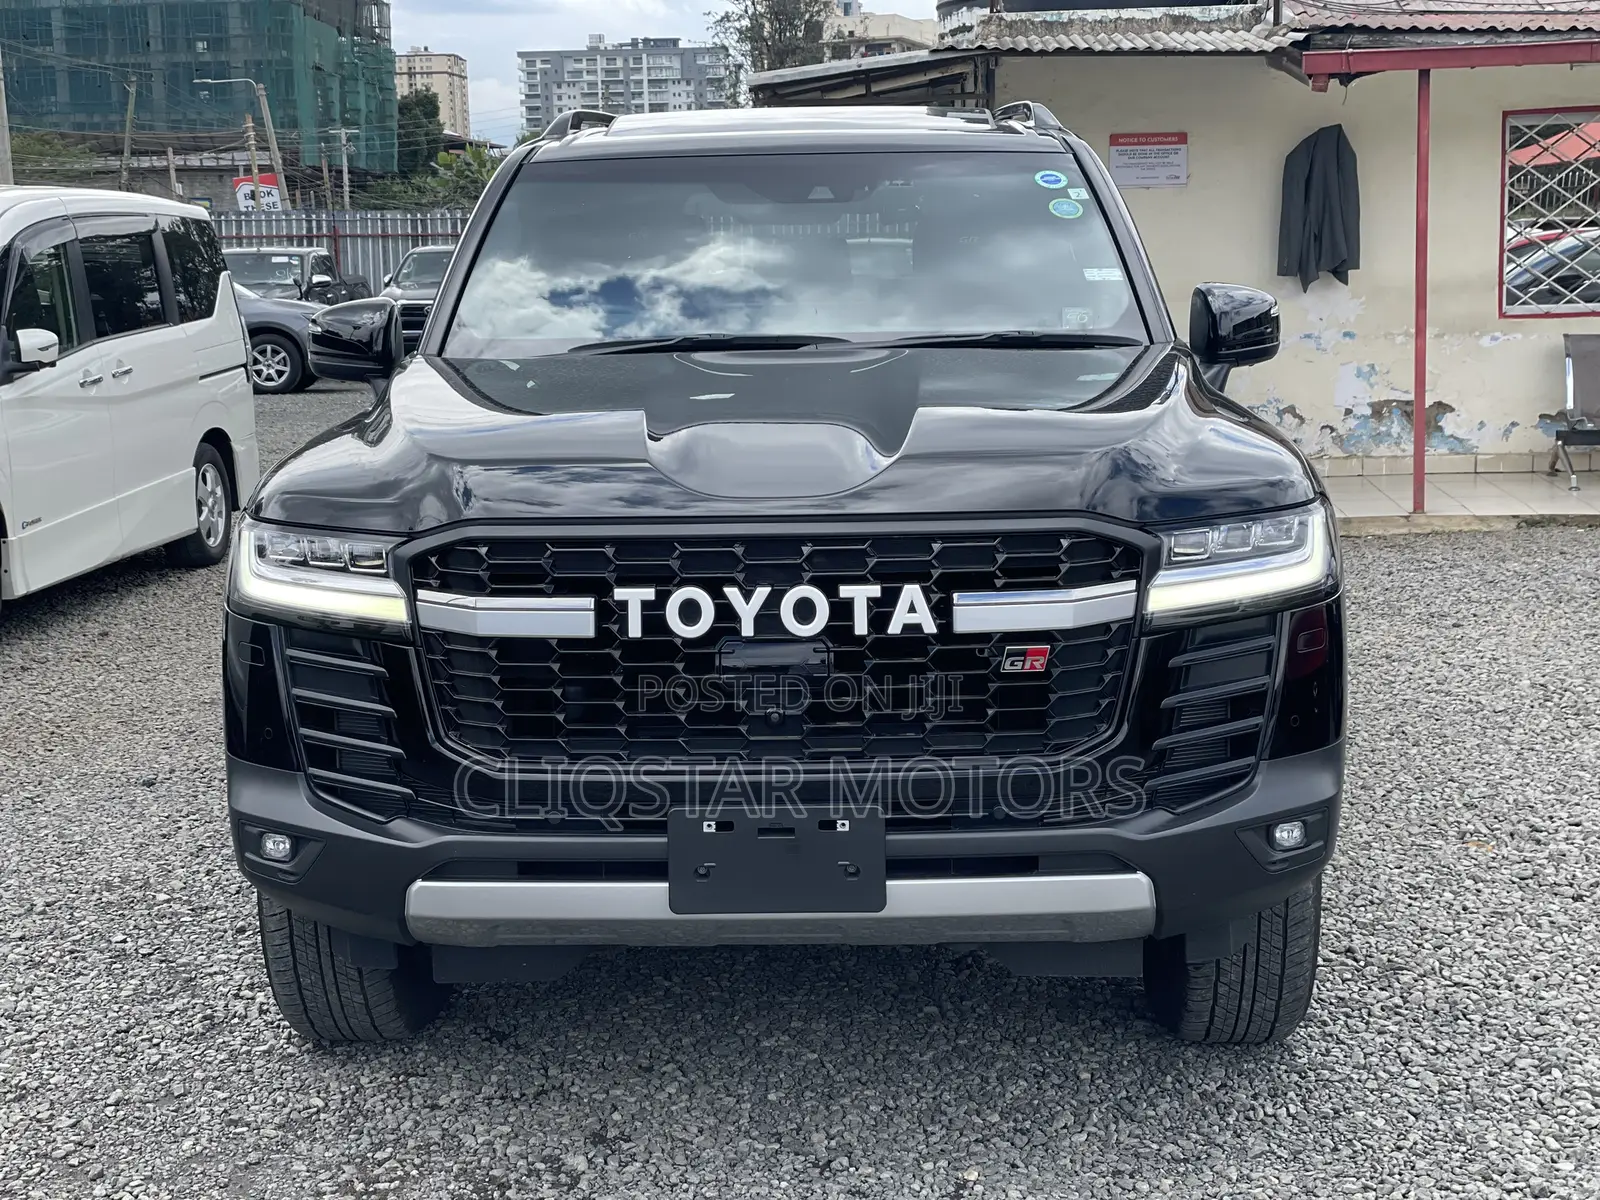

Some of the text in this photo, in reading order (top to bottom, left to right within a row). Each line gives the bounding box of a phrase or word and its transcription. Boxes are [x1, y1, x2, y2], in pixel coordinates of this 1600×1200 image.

[243, 189, 274, 200] BOK
[613, 585, 938, 638] TOYOTA
[1004, 656, 1045, 670] GR
